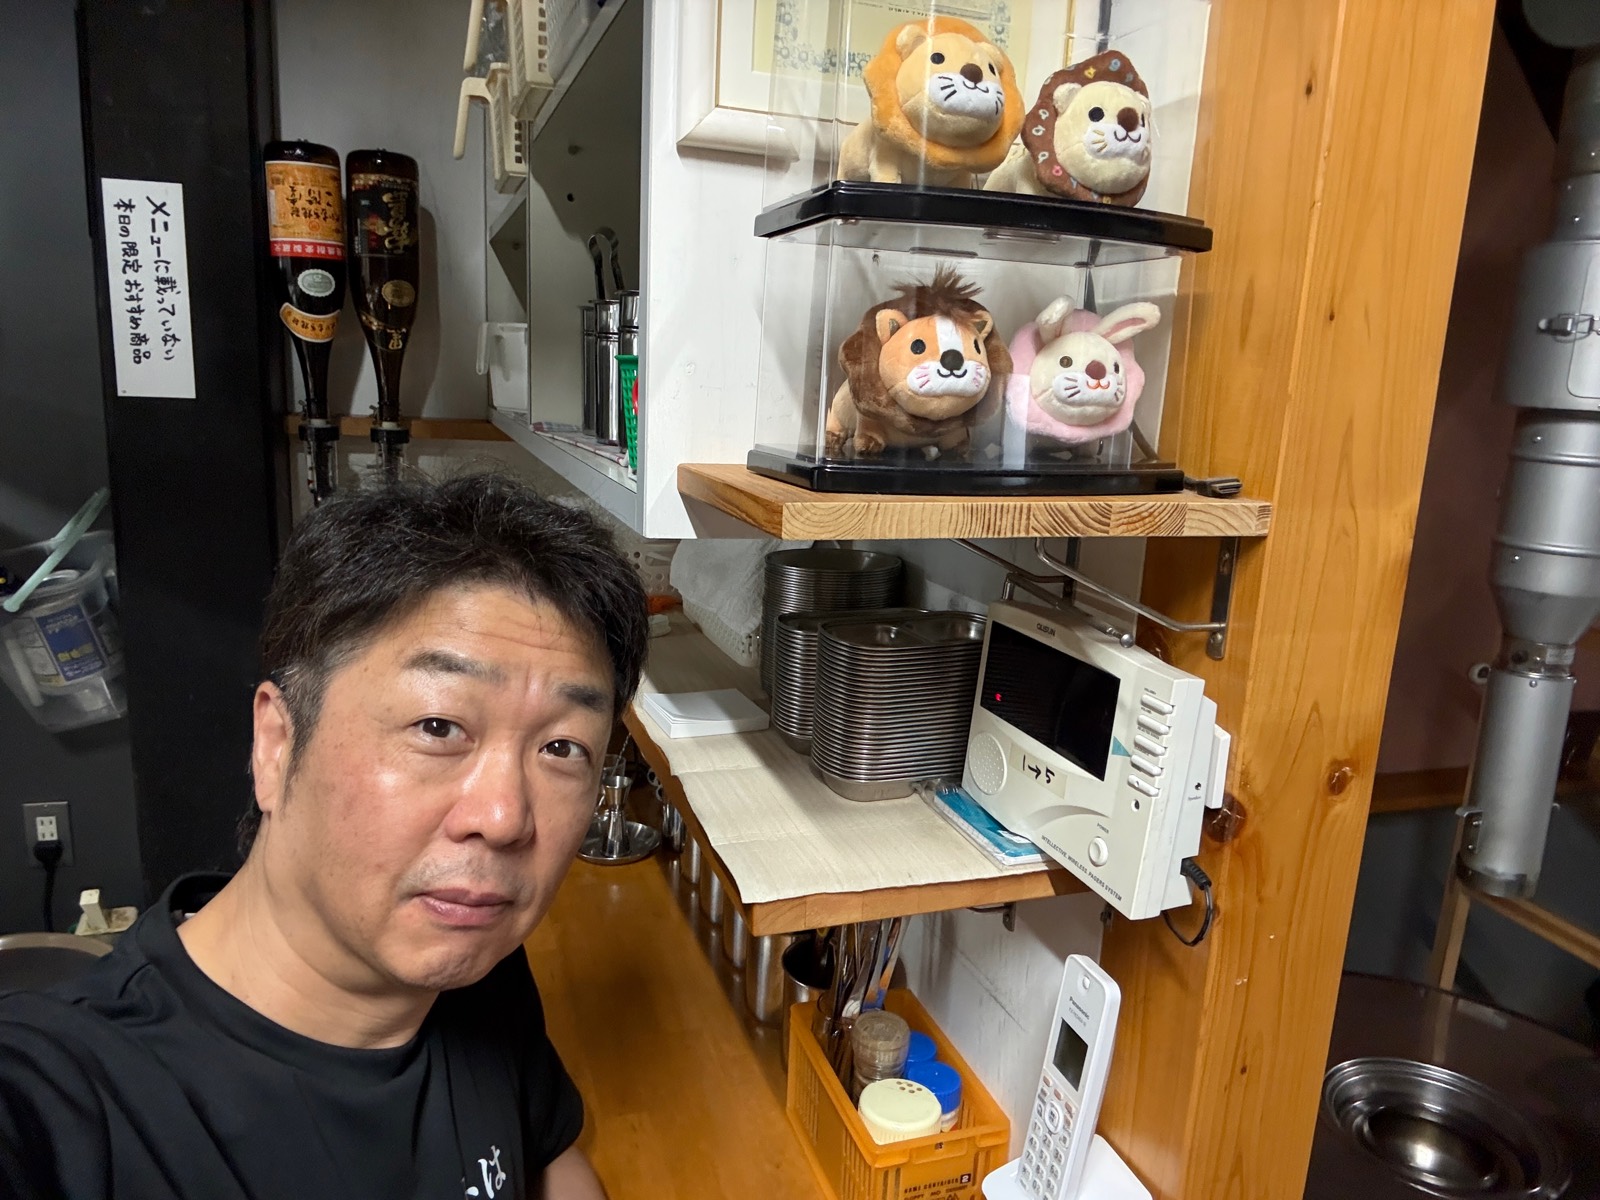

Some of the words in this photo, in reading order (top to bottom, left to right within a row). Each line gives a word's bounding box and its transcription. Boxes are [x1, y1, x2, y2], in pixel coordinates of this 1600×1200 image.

[146, 195, 181, 361] メニューに載っていない
[1045, 766, 1055, 784] 5
[1105, 884, 1122, 901] SYSTEM
